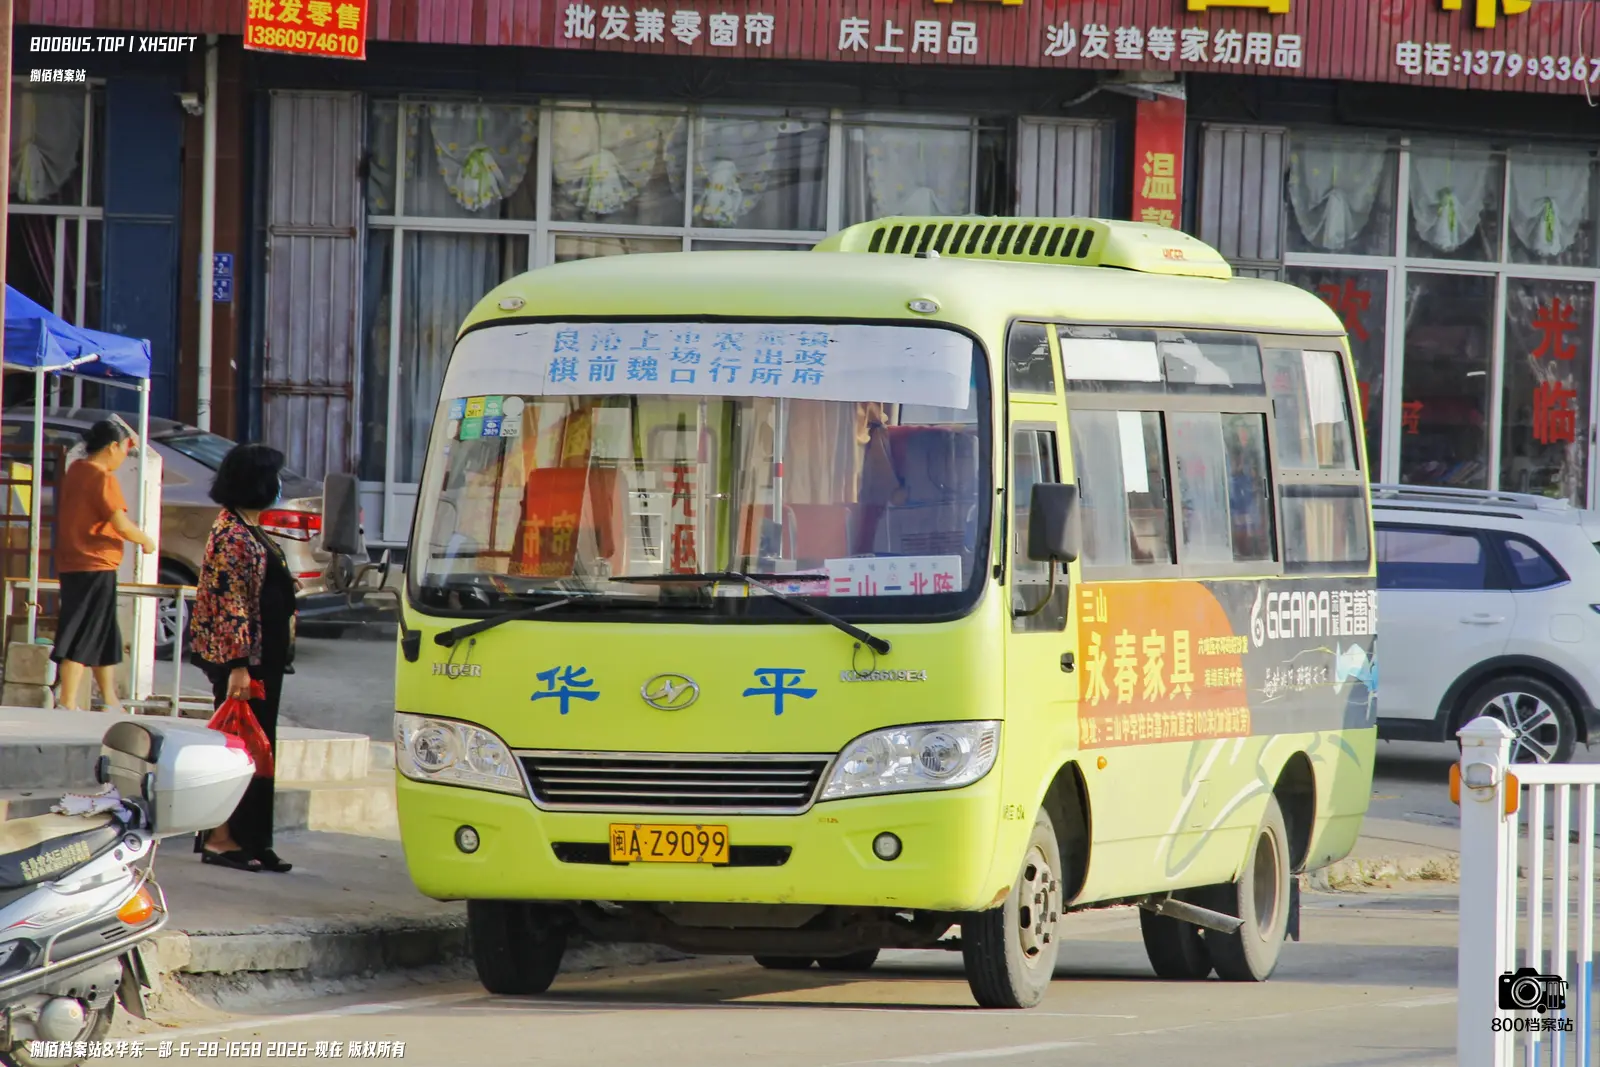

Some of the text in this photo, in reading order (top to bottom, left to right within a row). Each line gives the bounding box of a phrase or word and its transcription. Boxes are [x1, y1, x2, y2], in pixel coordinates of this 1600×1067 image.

[249, 0, 360, 30] 批发零售
[248, 25, 359, 54] 13860974610
[564, 3, 1303, 69] 批发兼零窗帘 床上用品 沙发垫等家纺用品
[1081, 588, 1109, 624] 三山
[432, 663, 482, 678] HIGER
[1085, 628, 1195, 706] 永春家具
[530, 665, 819, 716] 华 平
